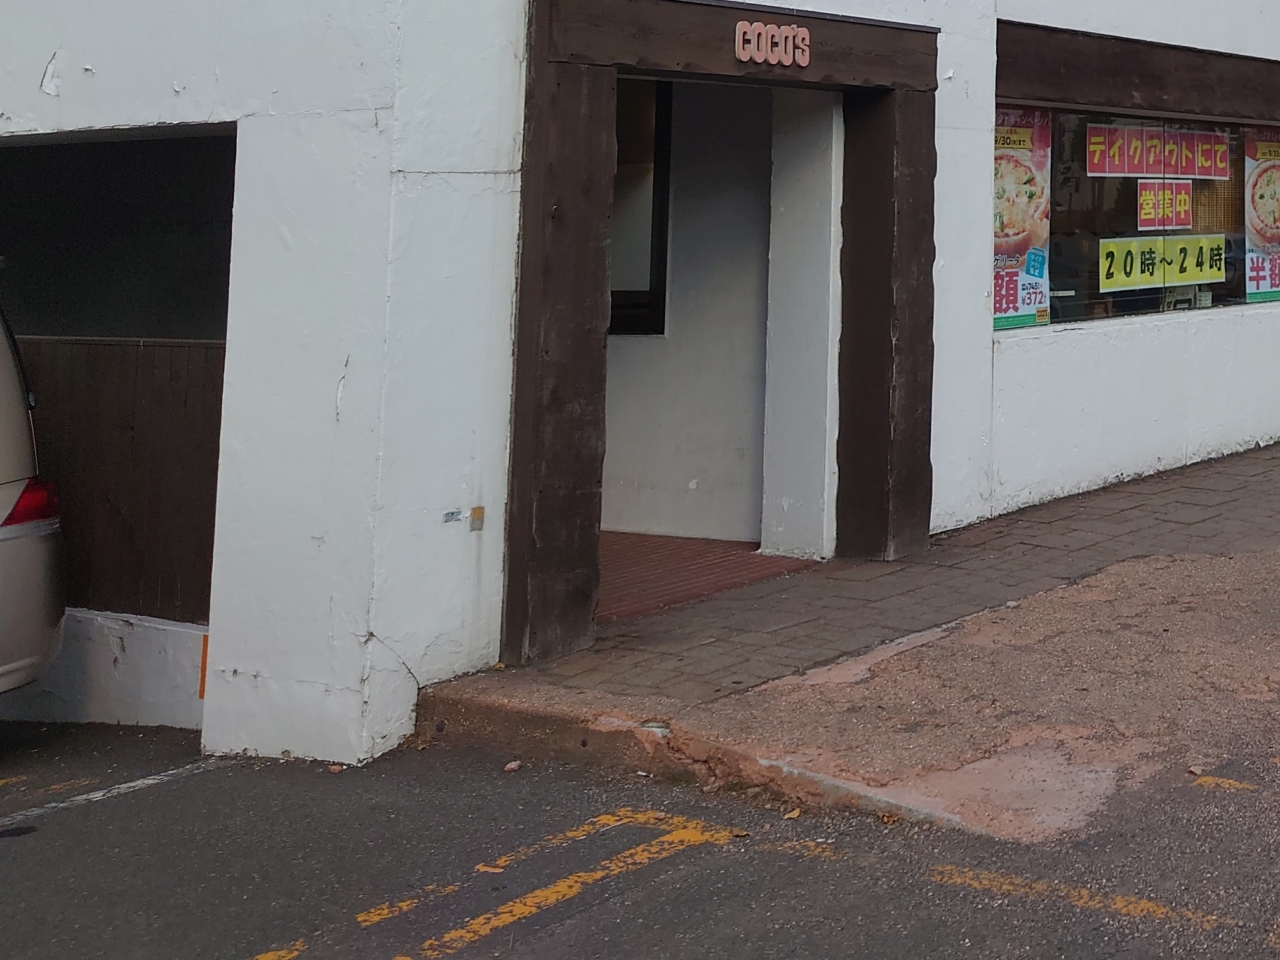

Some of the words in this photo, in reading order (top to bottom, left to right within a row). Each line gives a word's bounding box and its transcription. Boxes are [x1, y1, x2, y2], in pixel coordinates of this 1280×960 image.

[735, 20, 811, 68] COCO'S
[1089, 136, 1228, 169] テイクアウトにて
[1139, 190, 1190, 220] 営業中
[994, 270, 1020, 315] 額
